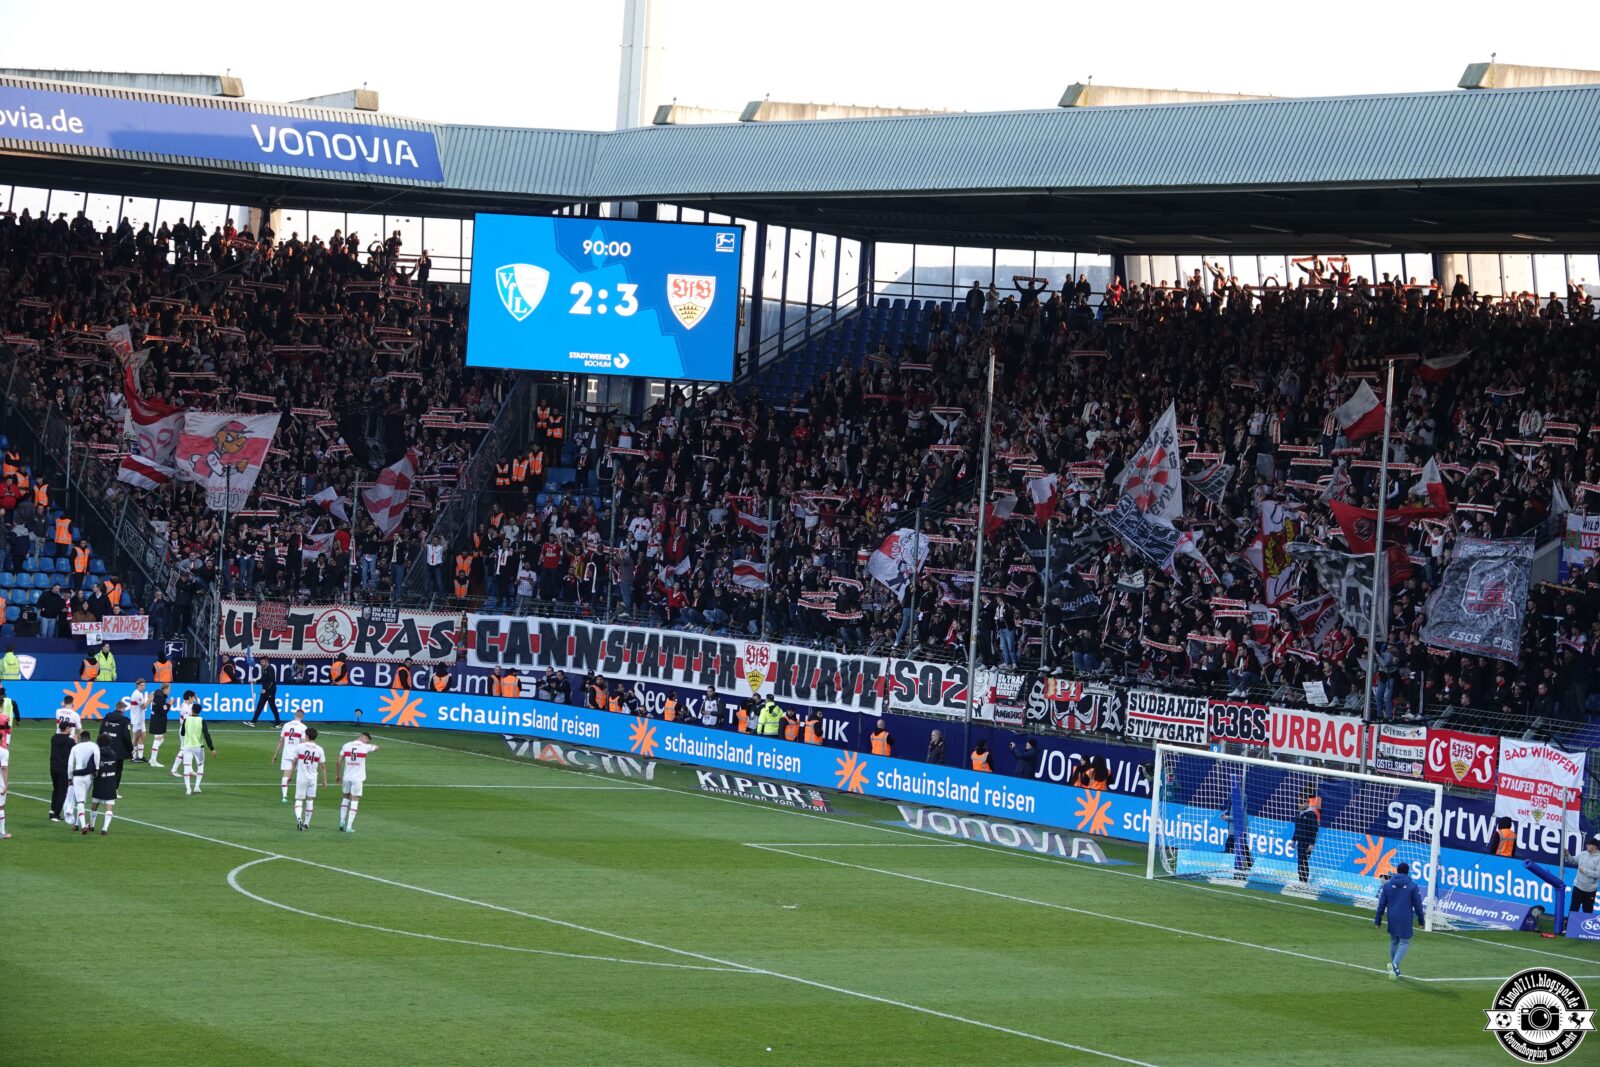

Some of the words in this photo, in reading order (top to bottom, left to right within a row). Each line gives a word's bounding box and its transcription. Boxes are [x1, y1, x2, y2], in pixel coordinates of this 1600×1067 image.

[251, 123, 419, 168] VONOVIA
[582, 239, 632, 257] 90:00
[671, 278, 712, 300] VfB
[568, 351, 612, 361] STADTWERKE
[584, 359, 612, 368] BOCHUM
[72, 622, 100, 632] SILAS
[476, 619, 737, 690] CANNSTATTER
[774, 649, 883, 710] KURVE
[1128, 692, 1206, 720] SÜDBANDE
[438, 702, 559, 731] schauinsland
[561, 713, 600, 738] reisen
[288, 727, 295, 741] 2
[1126, 718, 1205, 744] STUTTGART
[350, 747, 358, 762] 5
[665, 736, 753, 765] schauinsland
[757, 747, 801, 774] reisen
[1504, 747, 1527, 761] BAD
[1376, 759, 1412, 773] OSTELSHEIM
[695, 769, 805, 804] KIPOR
[701, 784, 768, 801] Generatoren
[876, 769, 980, 804] schauinsland
[984, 788, 1035, 813] reisen
[1500, 776, 1536, 794] STAUFER
[1501, 911, 1519, 922] Tor
